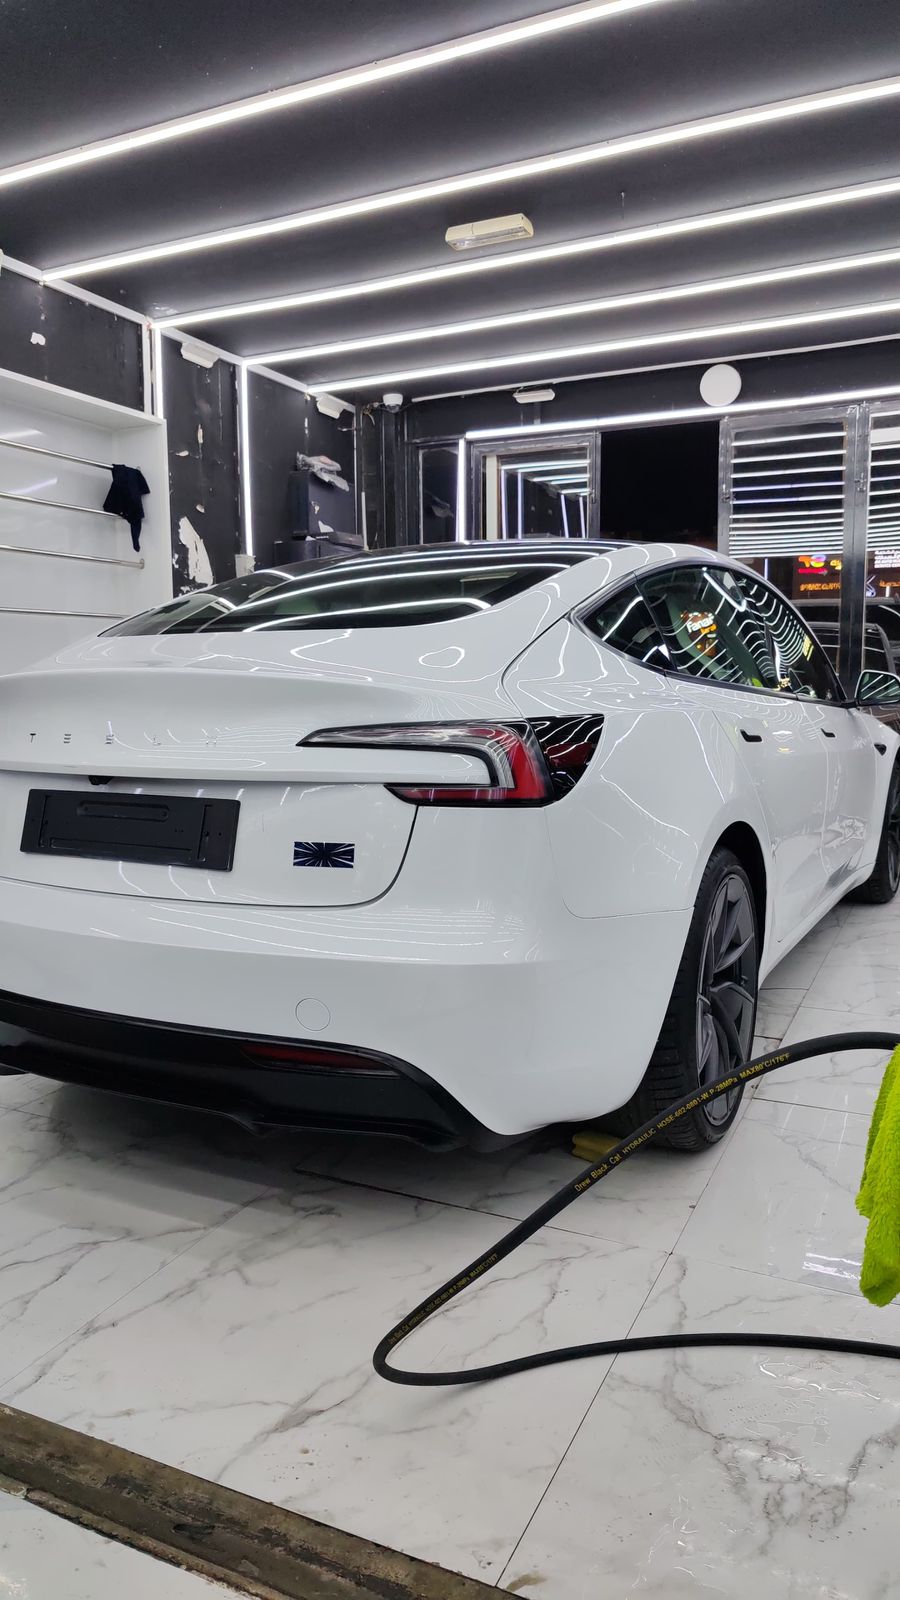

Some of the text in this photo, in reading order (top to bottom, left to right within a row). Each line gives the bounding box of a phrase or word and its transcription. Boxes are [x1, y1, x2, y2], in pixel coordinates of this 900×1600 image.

[574, 1177, 592, 1192] Drew
[609, 1153, 623, 1165] Cat
[622, 1127, 657, 1155] HYDRAULIC
